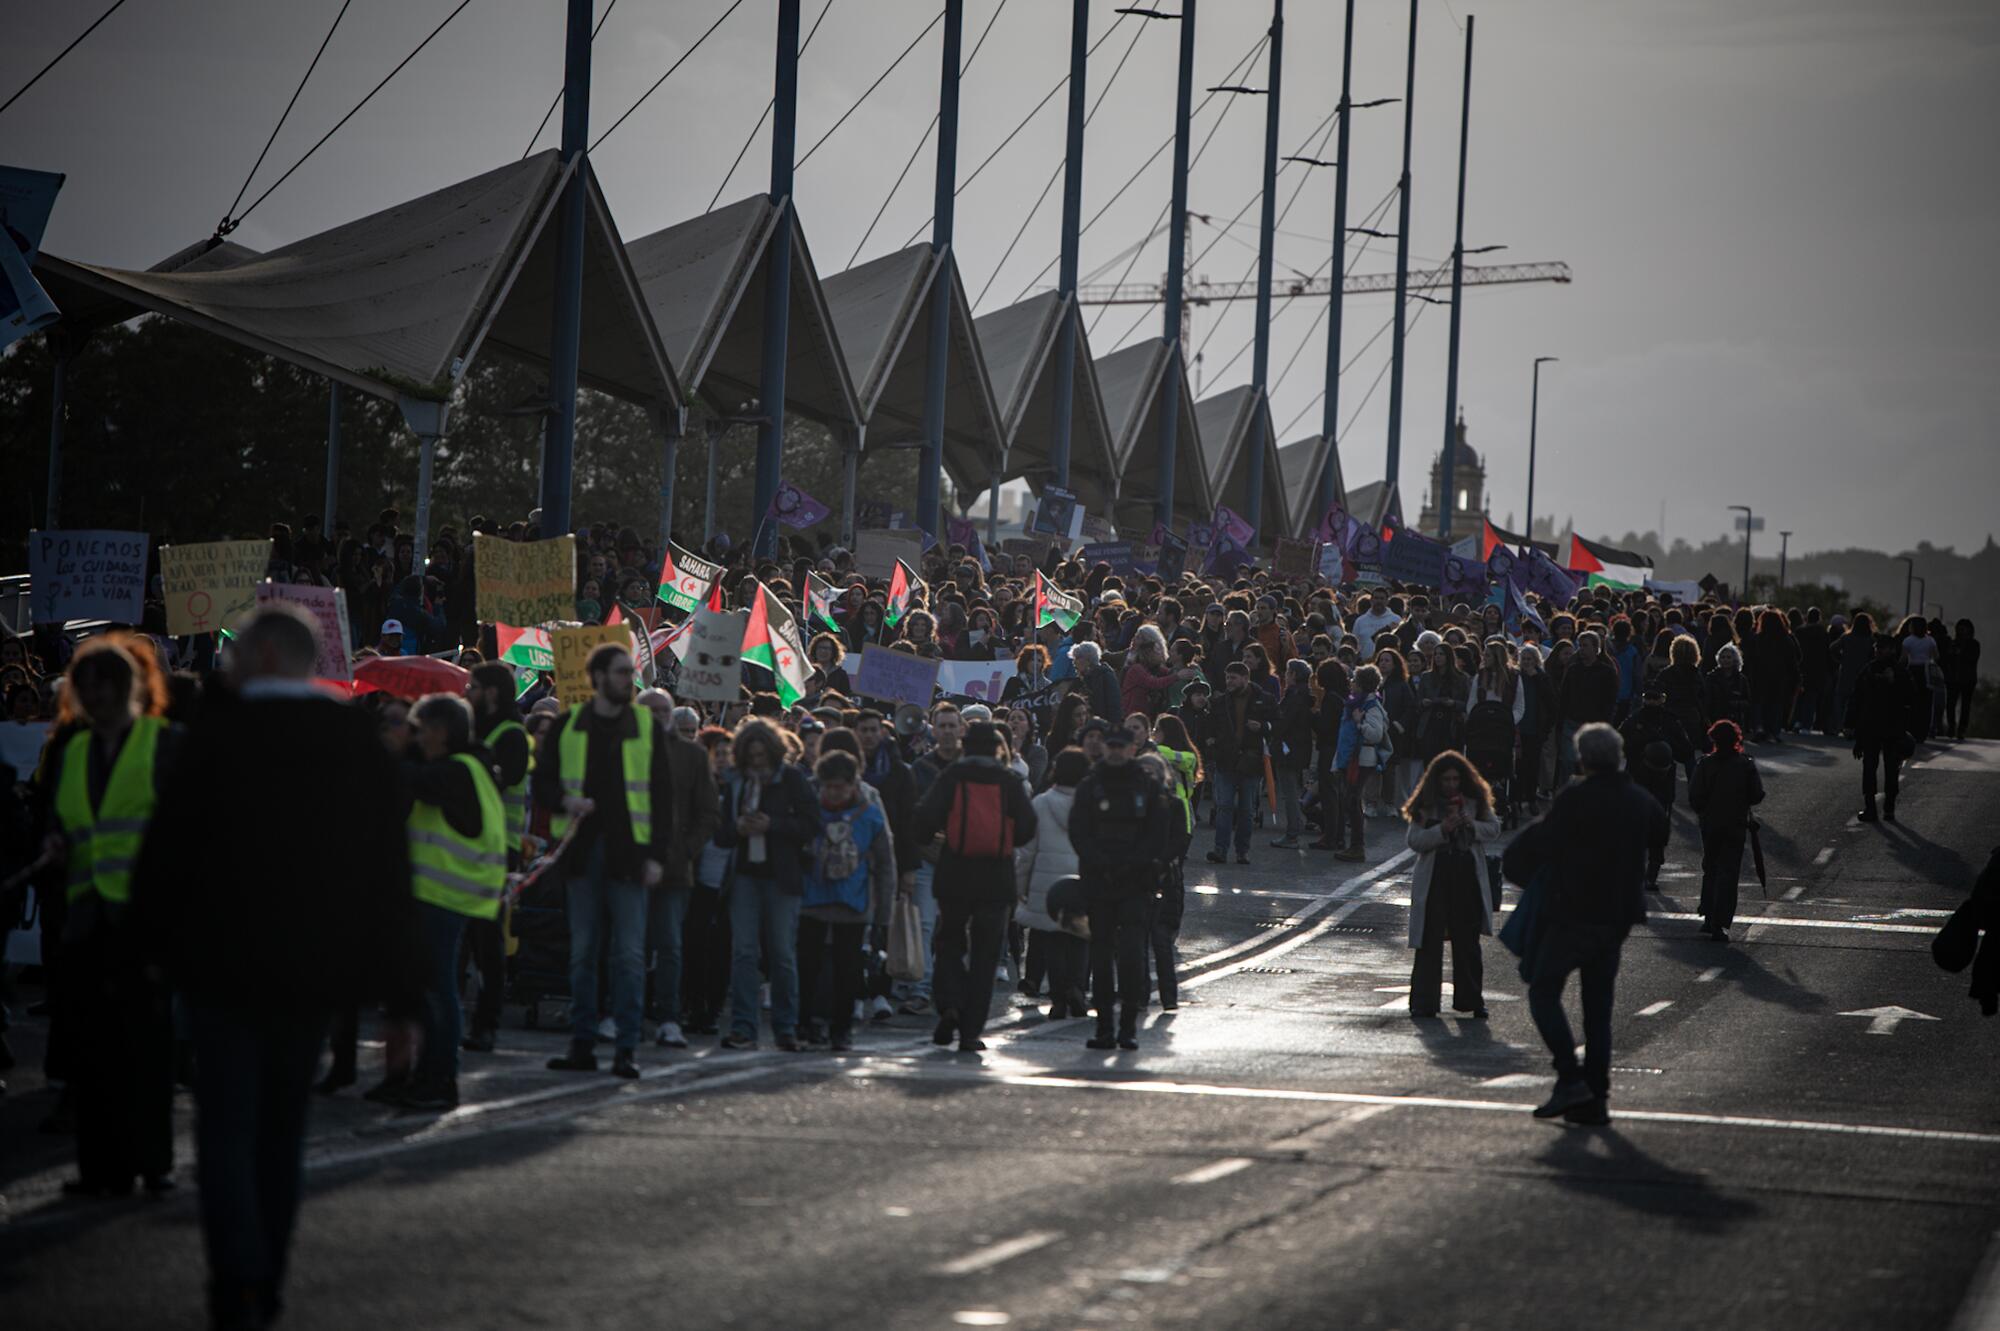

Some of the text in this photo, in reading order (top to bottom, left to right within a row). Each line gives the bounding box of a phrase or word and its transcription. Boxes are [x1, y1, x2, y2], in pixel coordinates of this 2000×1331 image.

[41, 537, 142, 563] PONEMOS
[81, 559, 142, 575] CUIDADOS
[679, 555, 711, 580] SAHARA
[102, 587, 132, 601] VIDA
[669, 591, 695, 609] LIBRE
